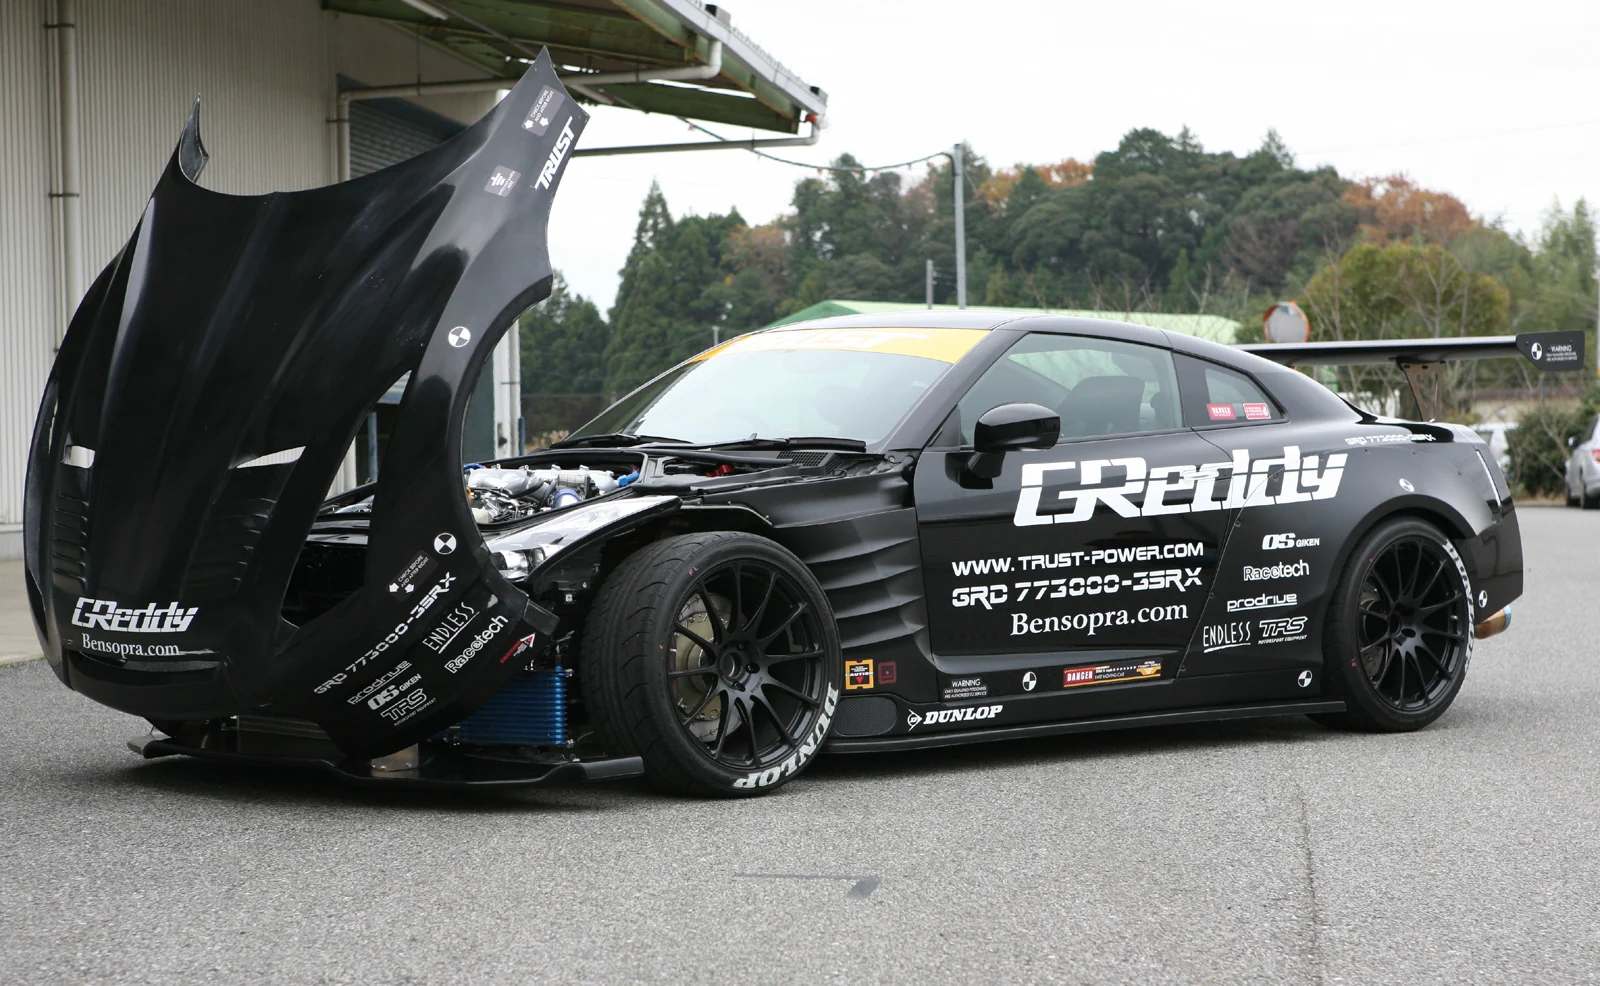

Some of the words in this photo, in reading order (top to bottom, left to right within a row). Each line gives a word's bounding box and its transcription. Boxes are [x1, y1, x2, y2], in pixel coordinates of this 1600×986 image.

[534, 116, 575, 190] TRUST
[1013, 445, 1349, 527] GReddy
[1262, 533, 1296, 550] OS
[1296, 538, 1320, 547] GIKEN
[397, 568, 411, 583] CHECK
[409, 555, 424, 570] BEFORE
[1244, 559, 1310, 581] Racetech
[71, 597, 199, 632] GReddy
[422, 602, 475, 651] ENDLESS
[1010, 603, 1188, 636] Bensopra.com
[82, 633, 180, 659] Bensopra.com
[444, 615, 509, 674] Racetech
[1203, 621, 1251, 647] ENDLESS
[1259, 616, 1308, 637] TRS
[367, 685, 400, 710] OS
[399, 673, 422, 692] GIKEN
[952, 679, 981, 687] WARNING
[1067, 671, 1093, 681] DANGER
[380, 688, 427, 721] TRS
[923, 705, 1003, 725] DUNLOP
[732, 682, 839, 788] DUNLOP
